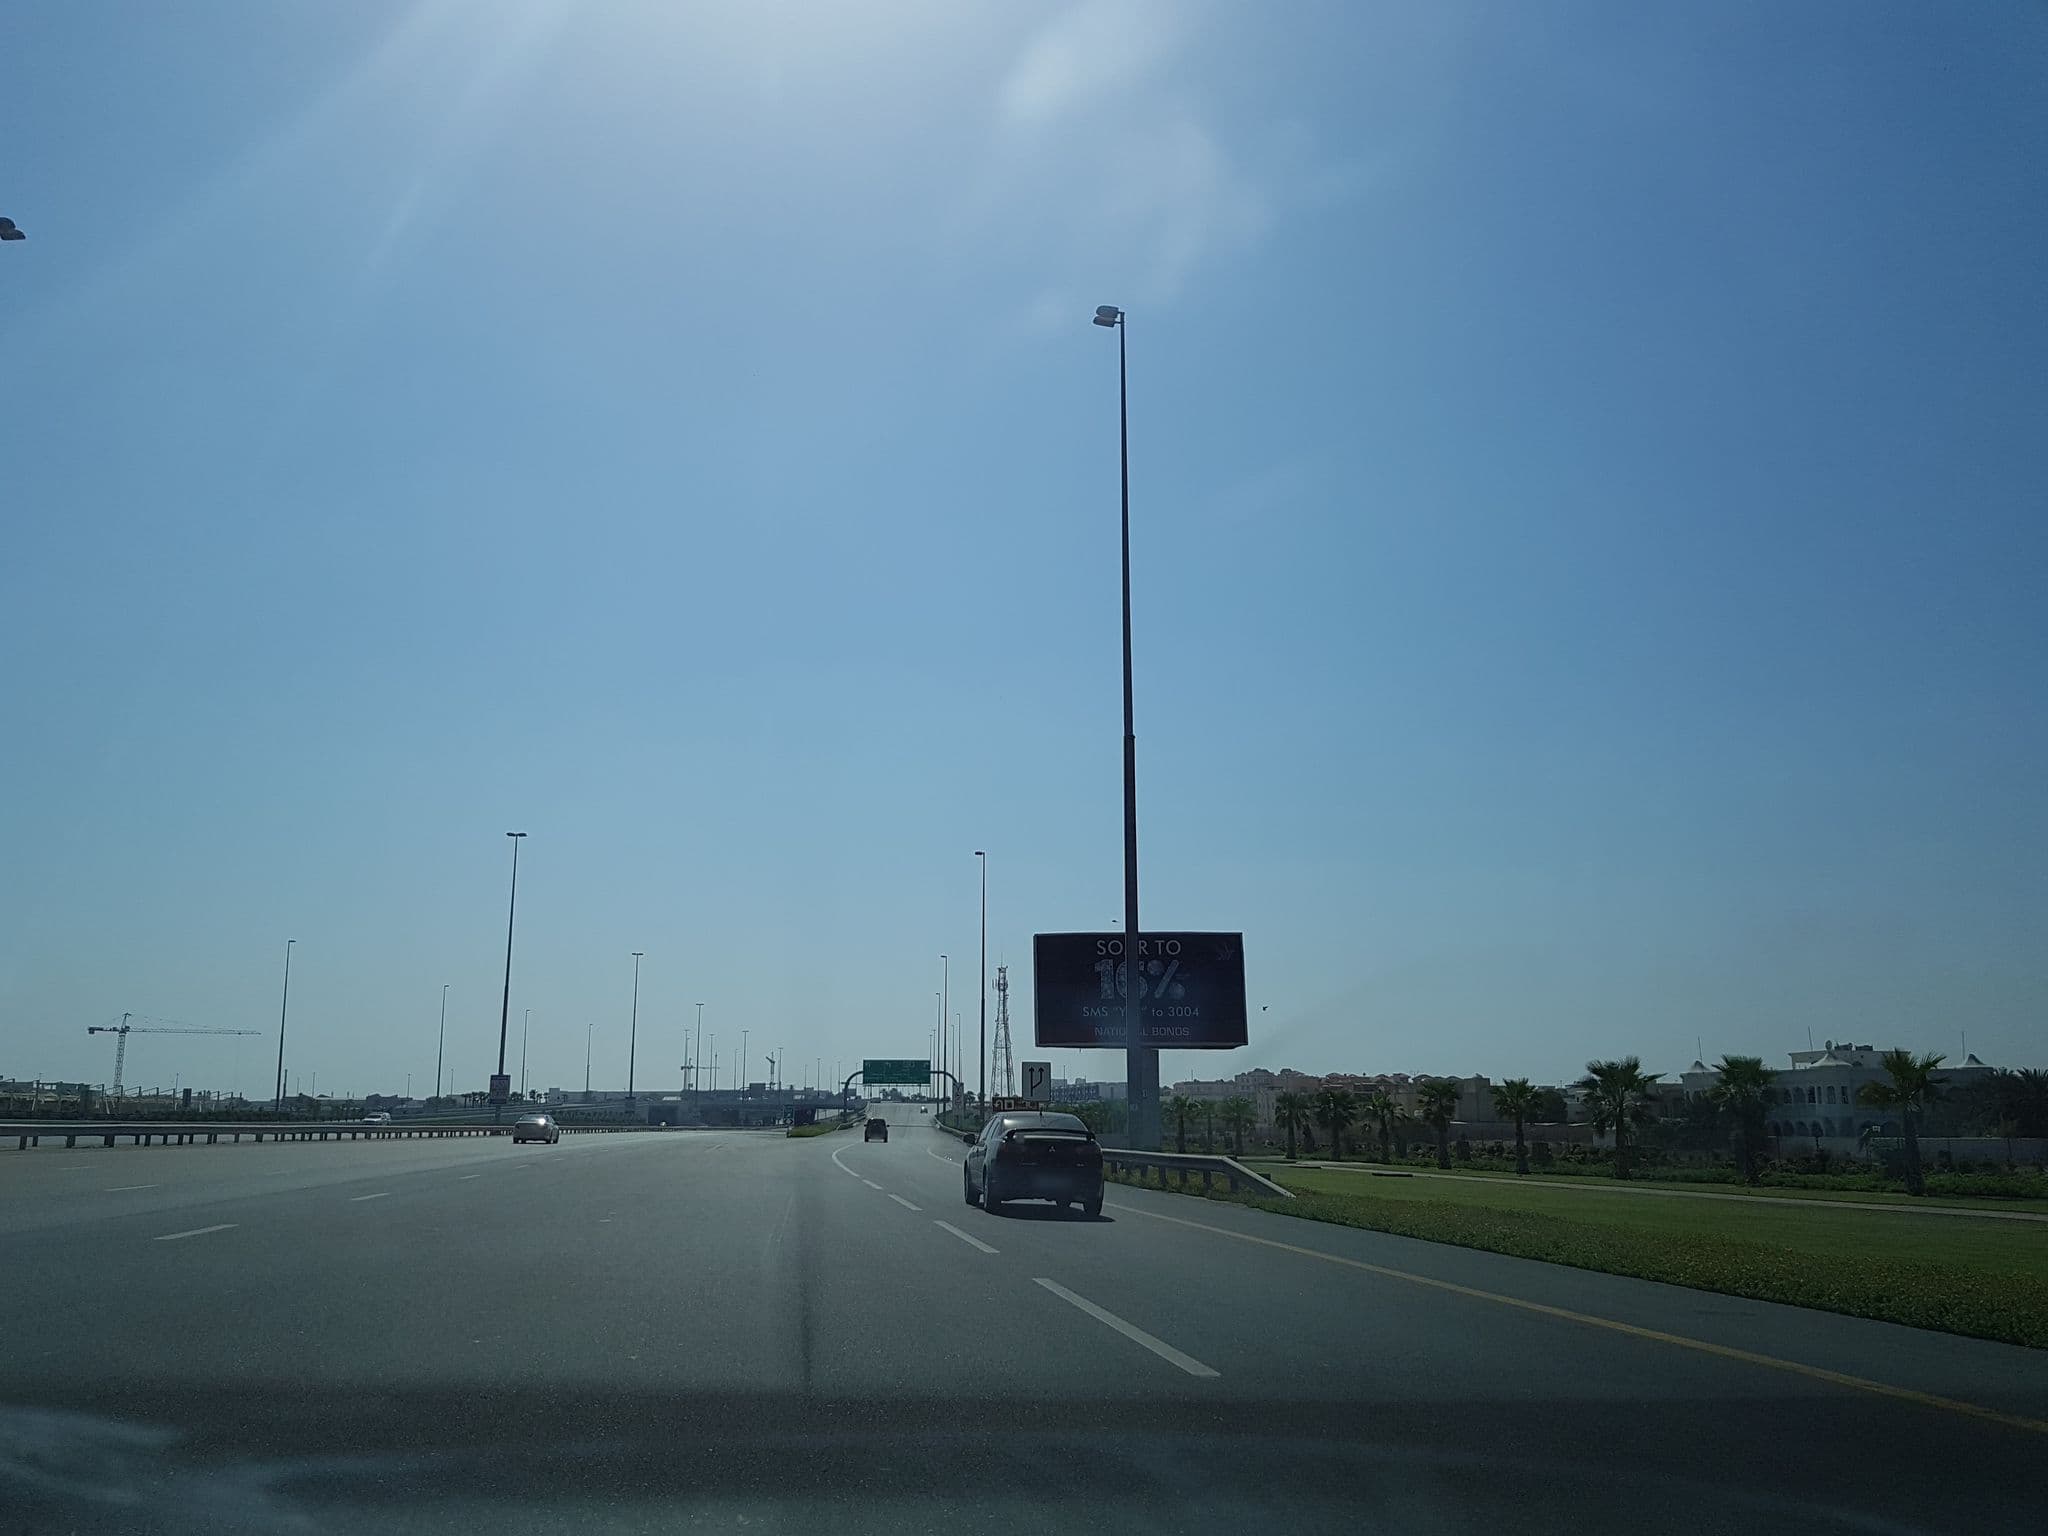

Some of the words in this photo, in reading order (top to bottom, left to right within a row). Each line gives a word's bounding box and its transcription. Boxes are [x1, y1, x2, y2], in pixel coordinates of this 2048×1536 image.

[1097, 939, 1149, 956] SOR
[1154, 939, 1181, 956] TO
[1083, 1006, 1108, 1017] SMS
[1152, 1007, 1163, 1017] to
[1168, 1006, 1200, 1017] 3004
